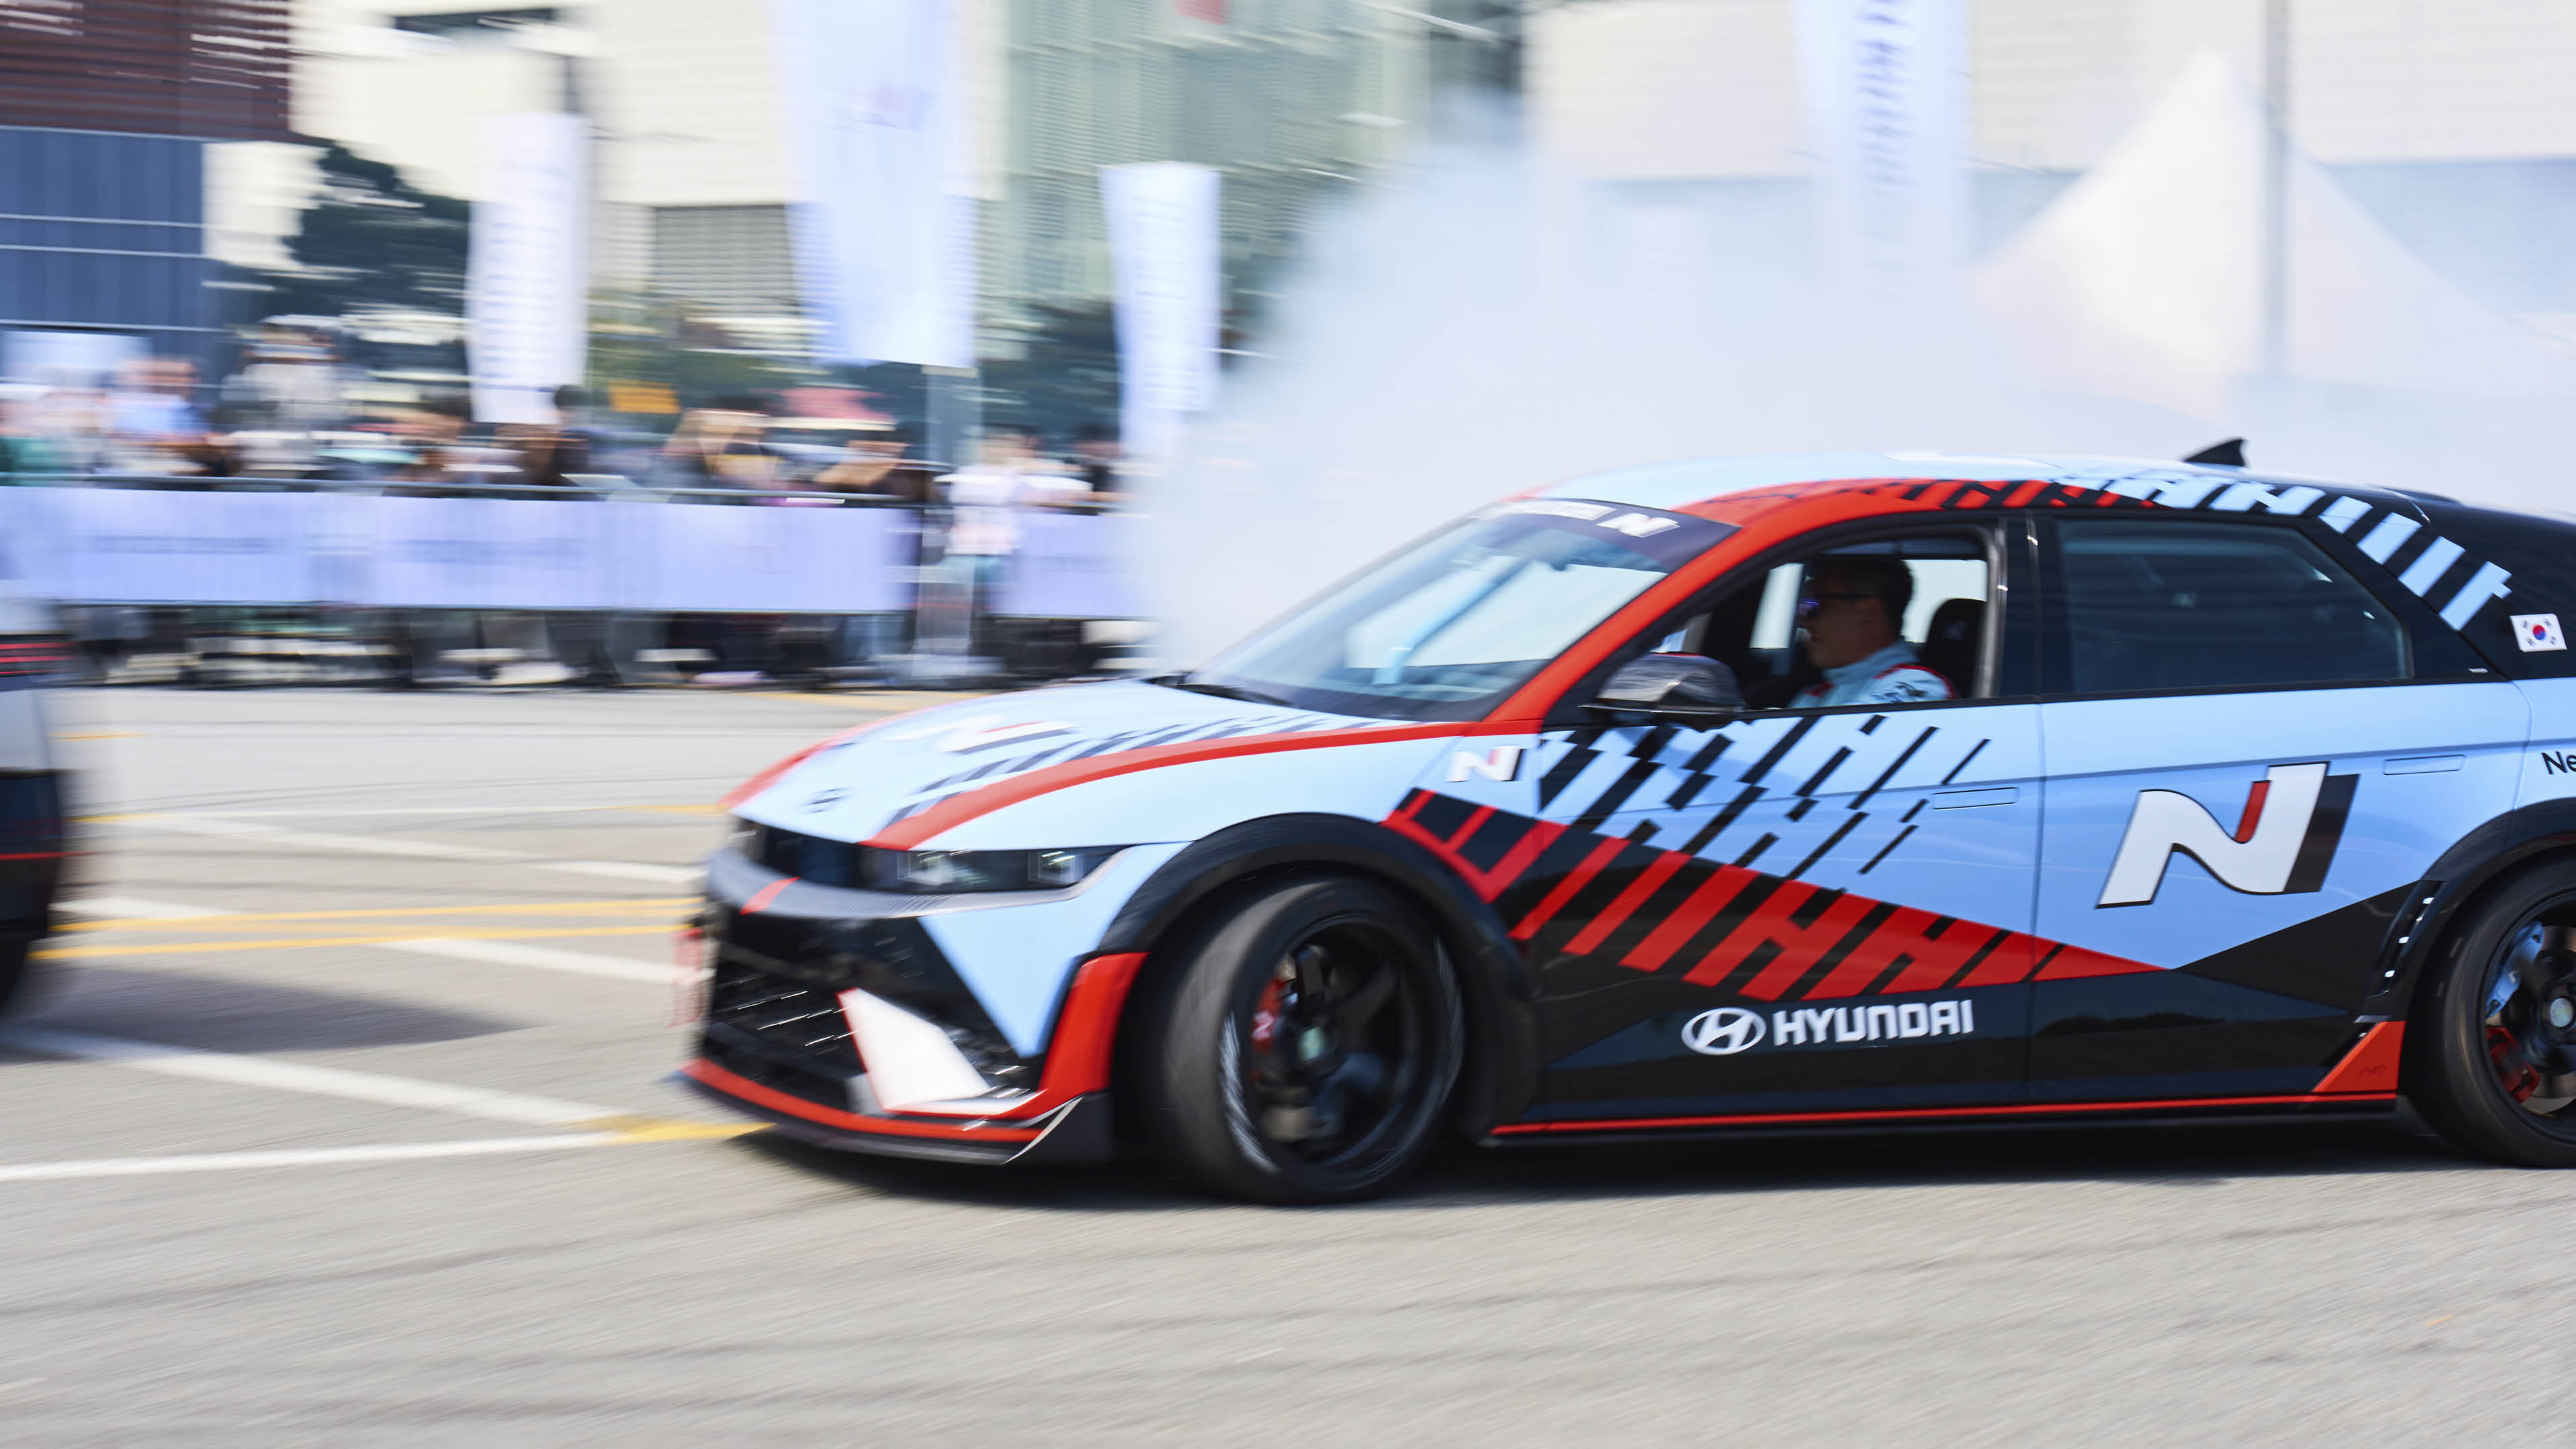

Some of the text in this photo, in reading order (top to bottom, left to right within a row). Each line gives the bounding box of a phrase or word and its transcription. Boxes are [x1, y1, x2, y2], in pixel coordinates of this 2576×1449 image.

[1446, 745, 1527, 782] N
[2094, 761, 2360, 909] N
[1772, 999, 1974, 1046] HYUNDAI
